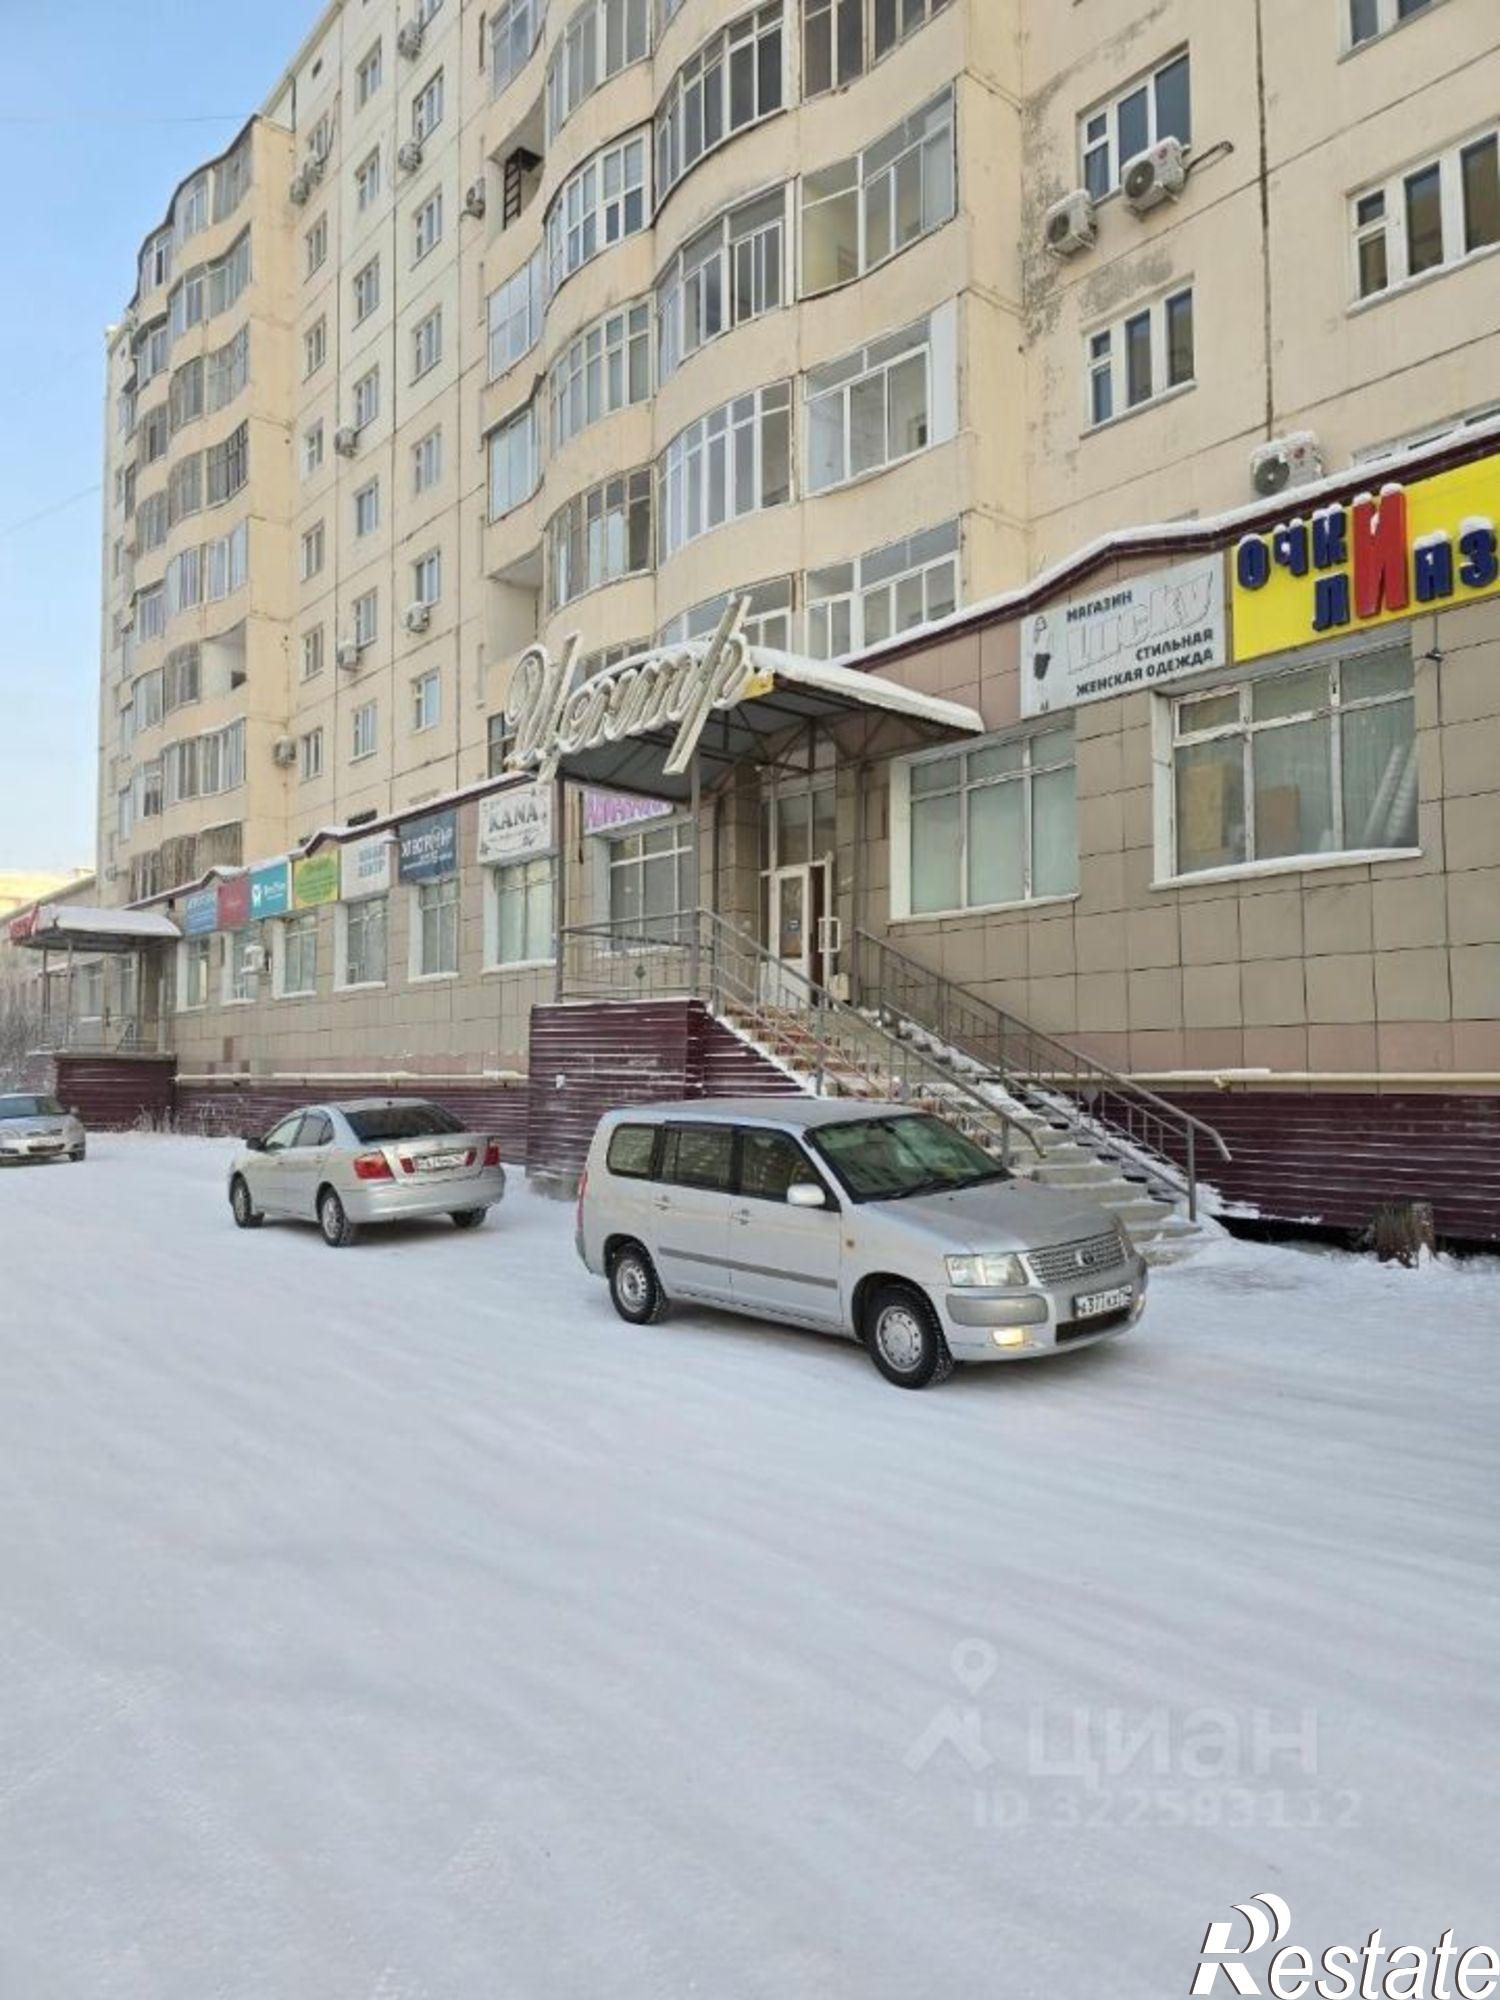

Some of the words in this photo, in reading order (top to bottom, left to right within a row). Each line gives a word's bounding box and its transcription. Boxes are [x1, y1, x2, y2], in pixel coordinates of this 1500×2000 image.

[1237, 484, 1409, 618] ОЧКИ
[1066, 589, 1133, 623] МАГАЗИН
[1135, 627, 1214, 661] СТИЛЬНАЯ
[1076, 667, 1143, 697] ЖЕНСКАЯ
[1146, 647, 1214, 678] ОДЕЖДА
